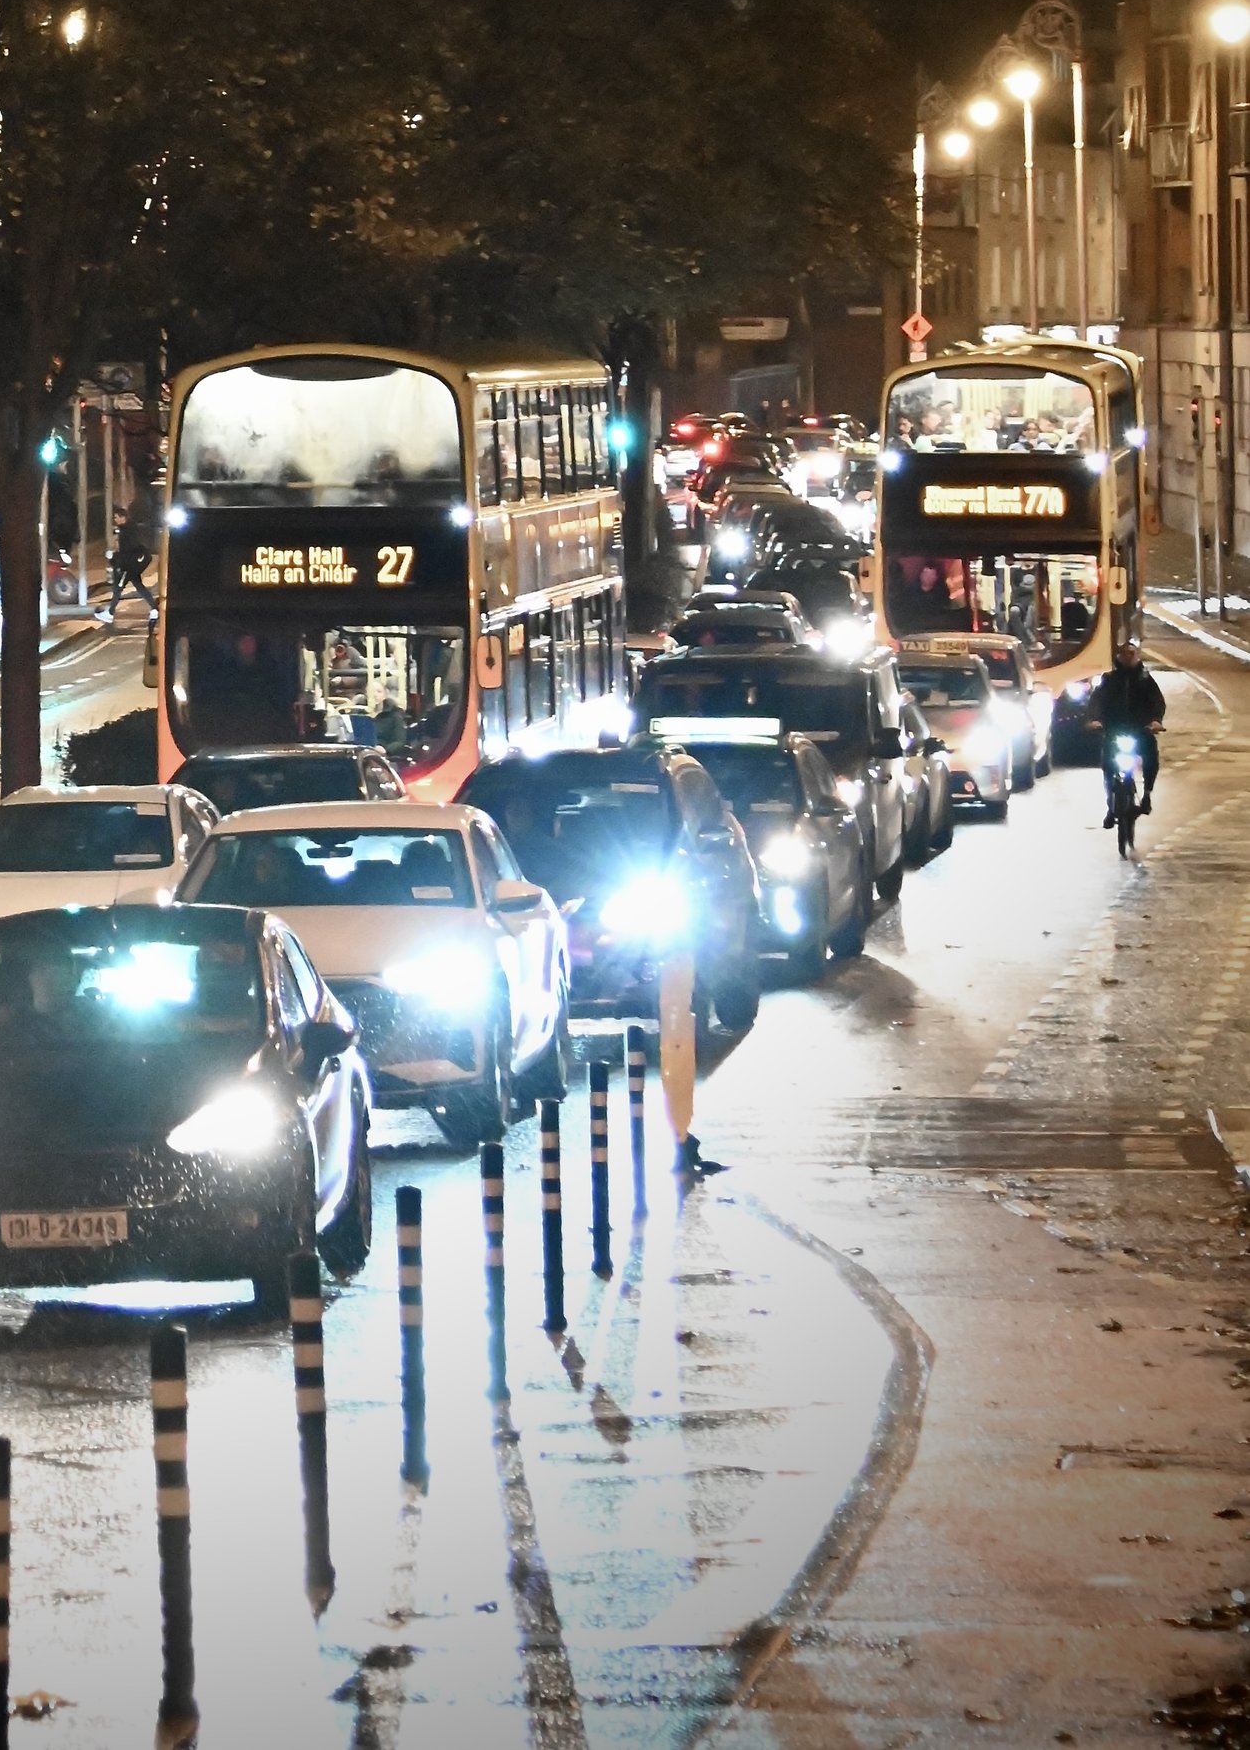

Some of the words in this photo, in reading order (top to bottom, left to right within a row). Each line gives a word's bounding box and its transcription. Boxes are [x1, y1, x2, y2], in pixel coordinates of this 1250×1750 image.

[1023, 485, 1064, 516] 77A
[255, 546, 303, 565] Clare
[308, 546, 344, 565] Hall
[377, 545, 413, 584] 27
[241, 564, 280, 584] Halla
[284, 567, 305, 584] an
[901, 641, 929, 651] TAXI
